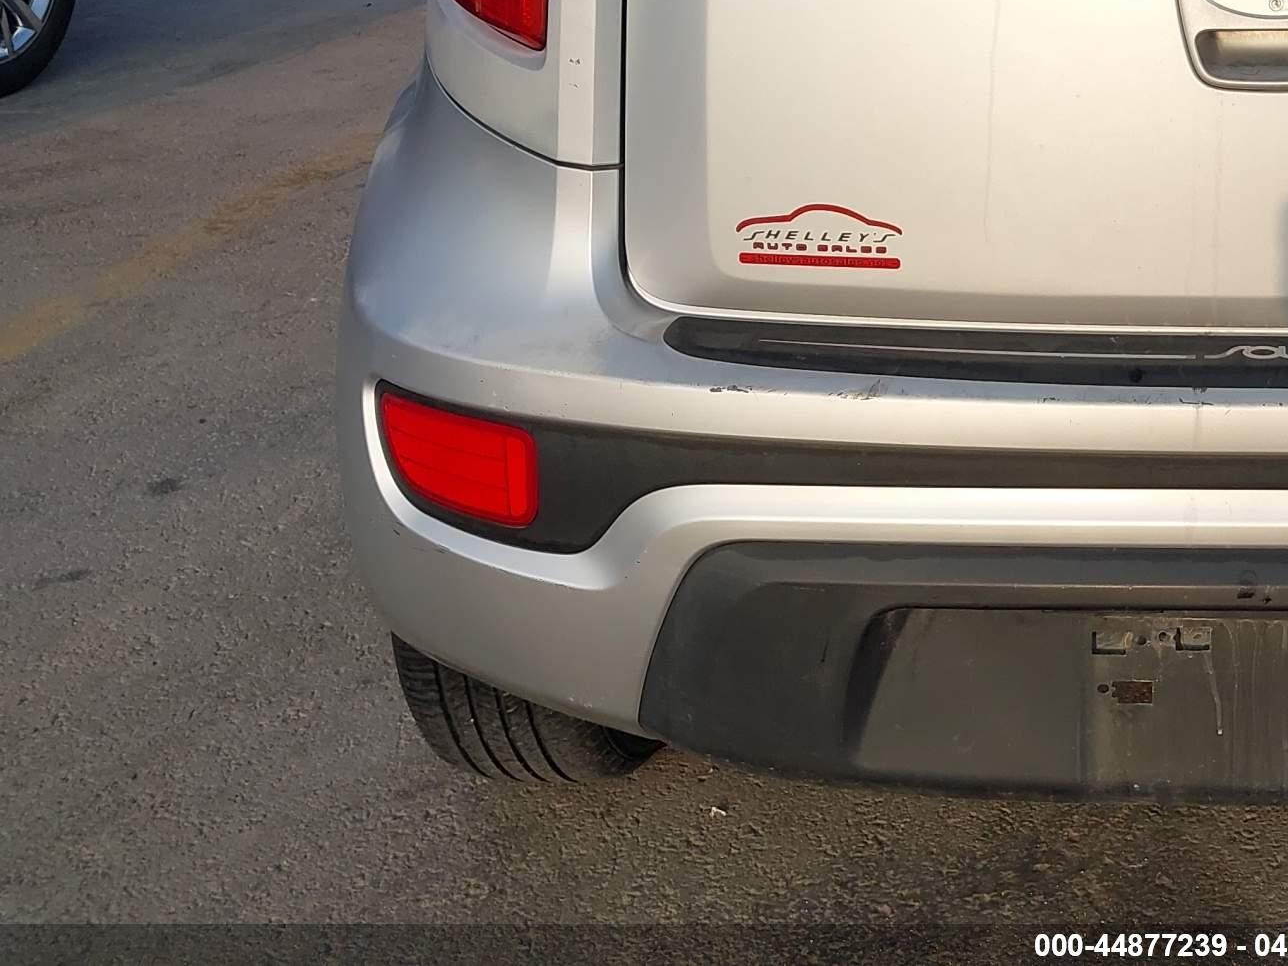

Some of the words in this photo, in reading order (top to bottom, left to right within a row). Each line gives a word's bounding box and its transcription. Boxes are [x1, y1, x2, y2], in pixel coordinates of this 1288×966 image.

[743, 229, 896, 243] SHELLEY'S
[752, 241, 808, 251] AUTO
[816, 244, 888, 254] SALES
